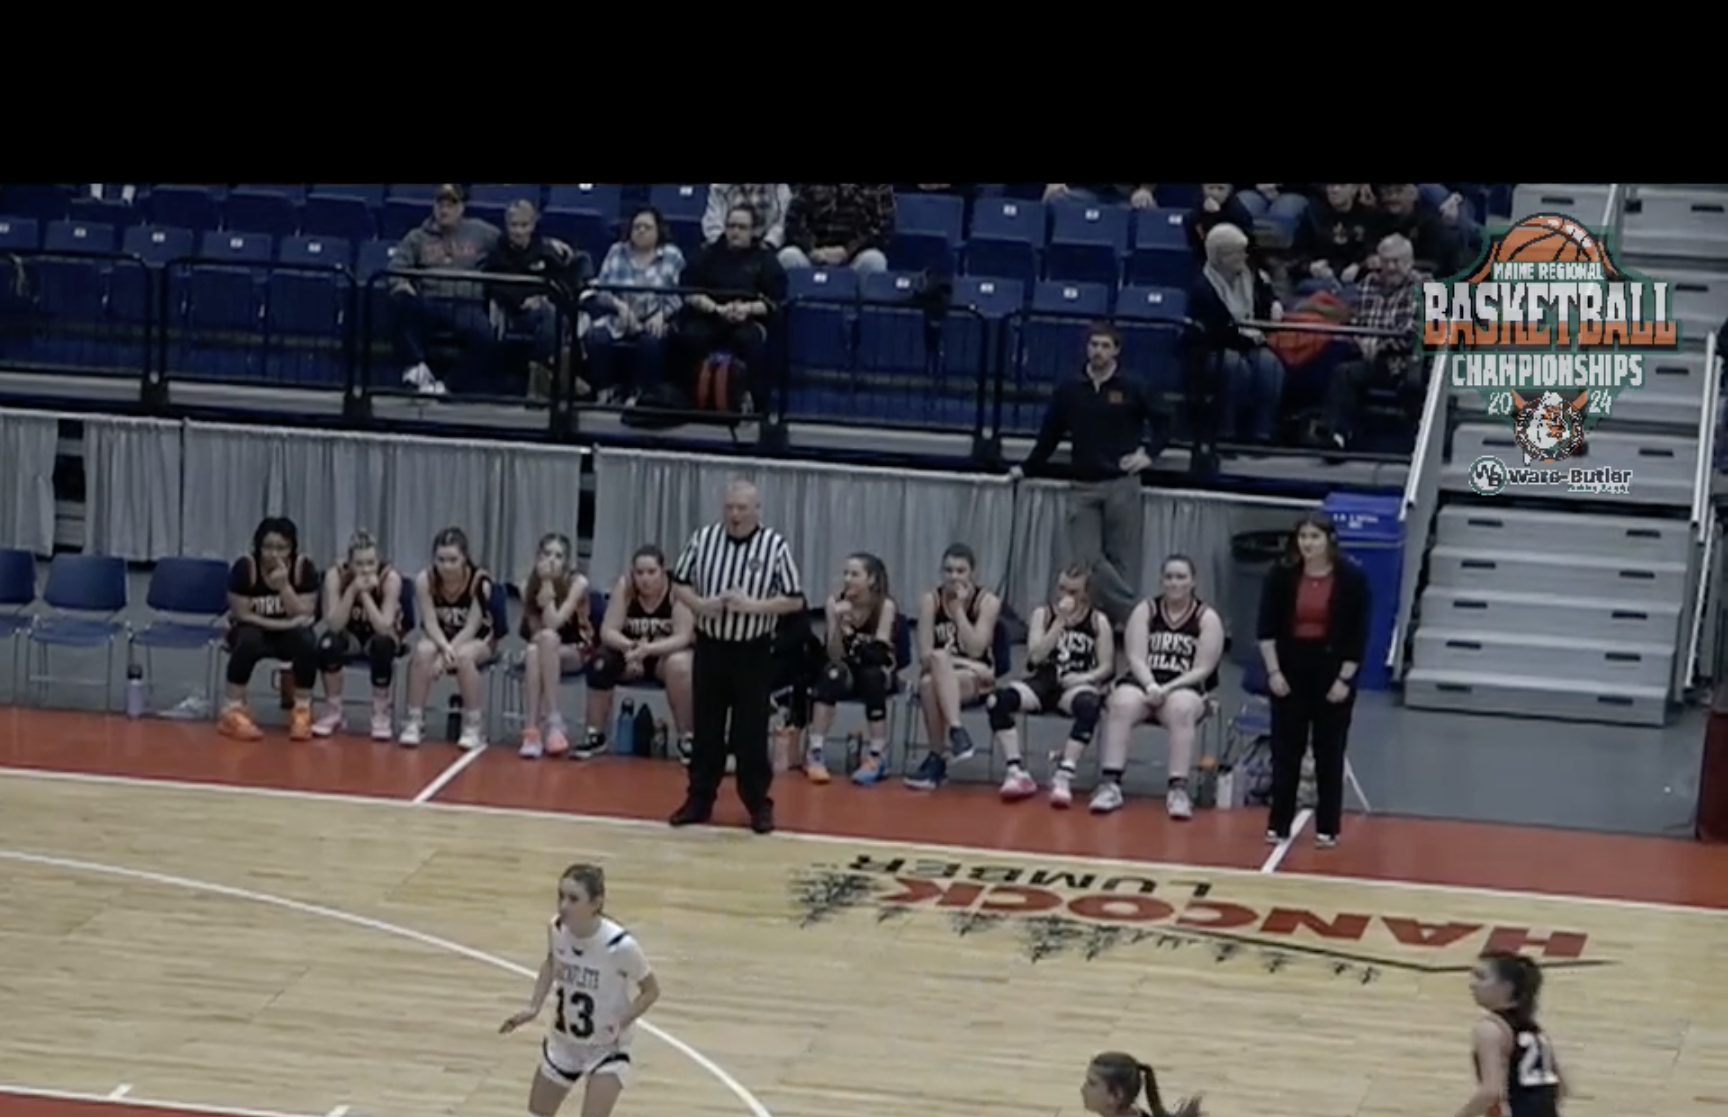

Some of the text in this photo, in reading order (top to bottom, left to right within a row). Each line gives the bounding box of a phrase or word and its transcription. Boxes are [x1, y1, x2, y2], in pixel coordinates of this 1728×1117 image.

[849, 854, 1212, 897] LUMBER
[880, 877, 1588, 958] HANCOCK
[554, 987, 595, 1039] 13
